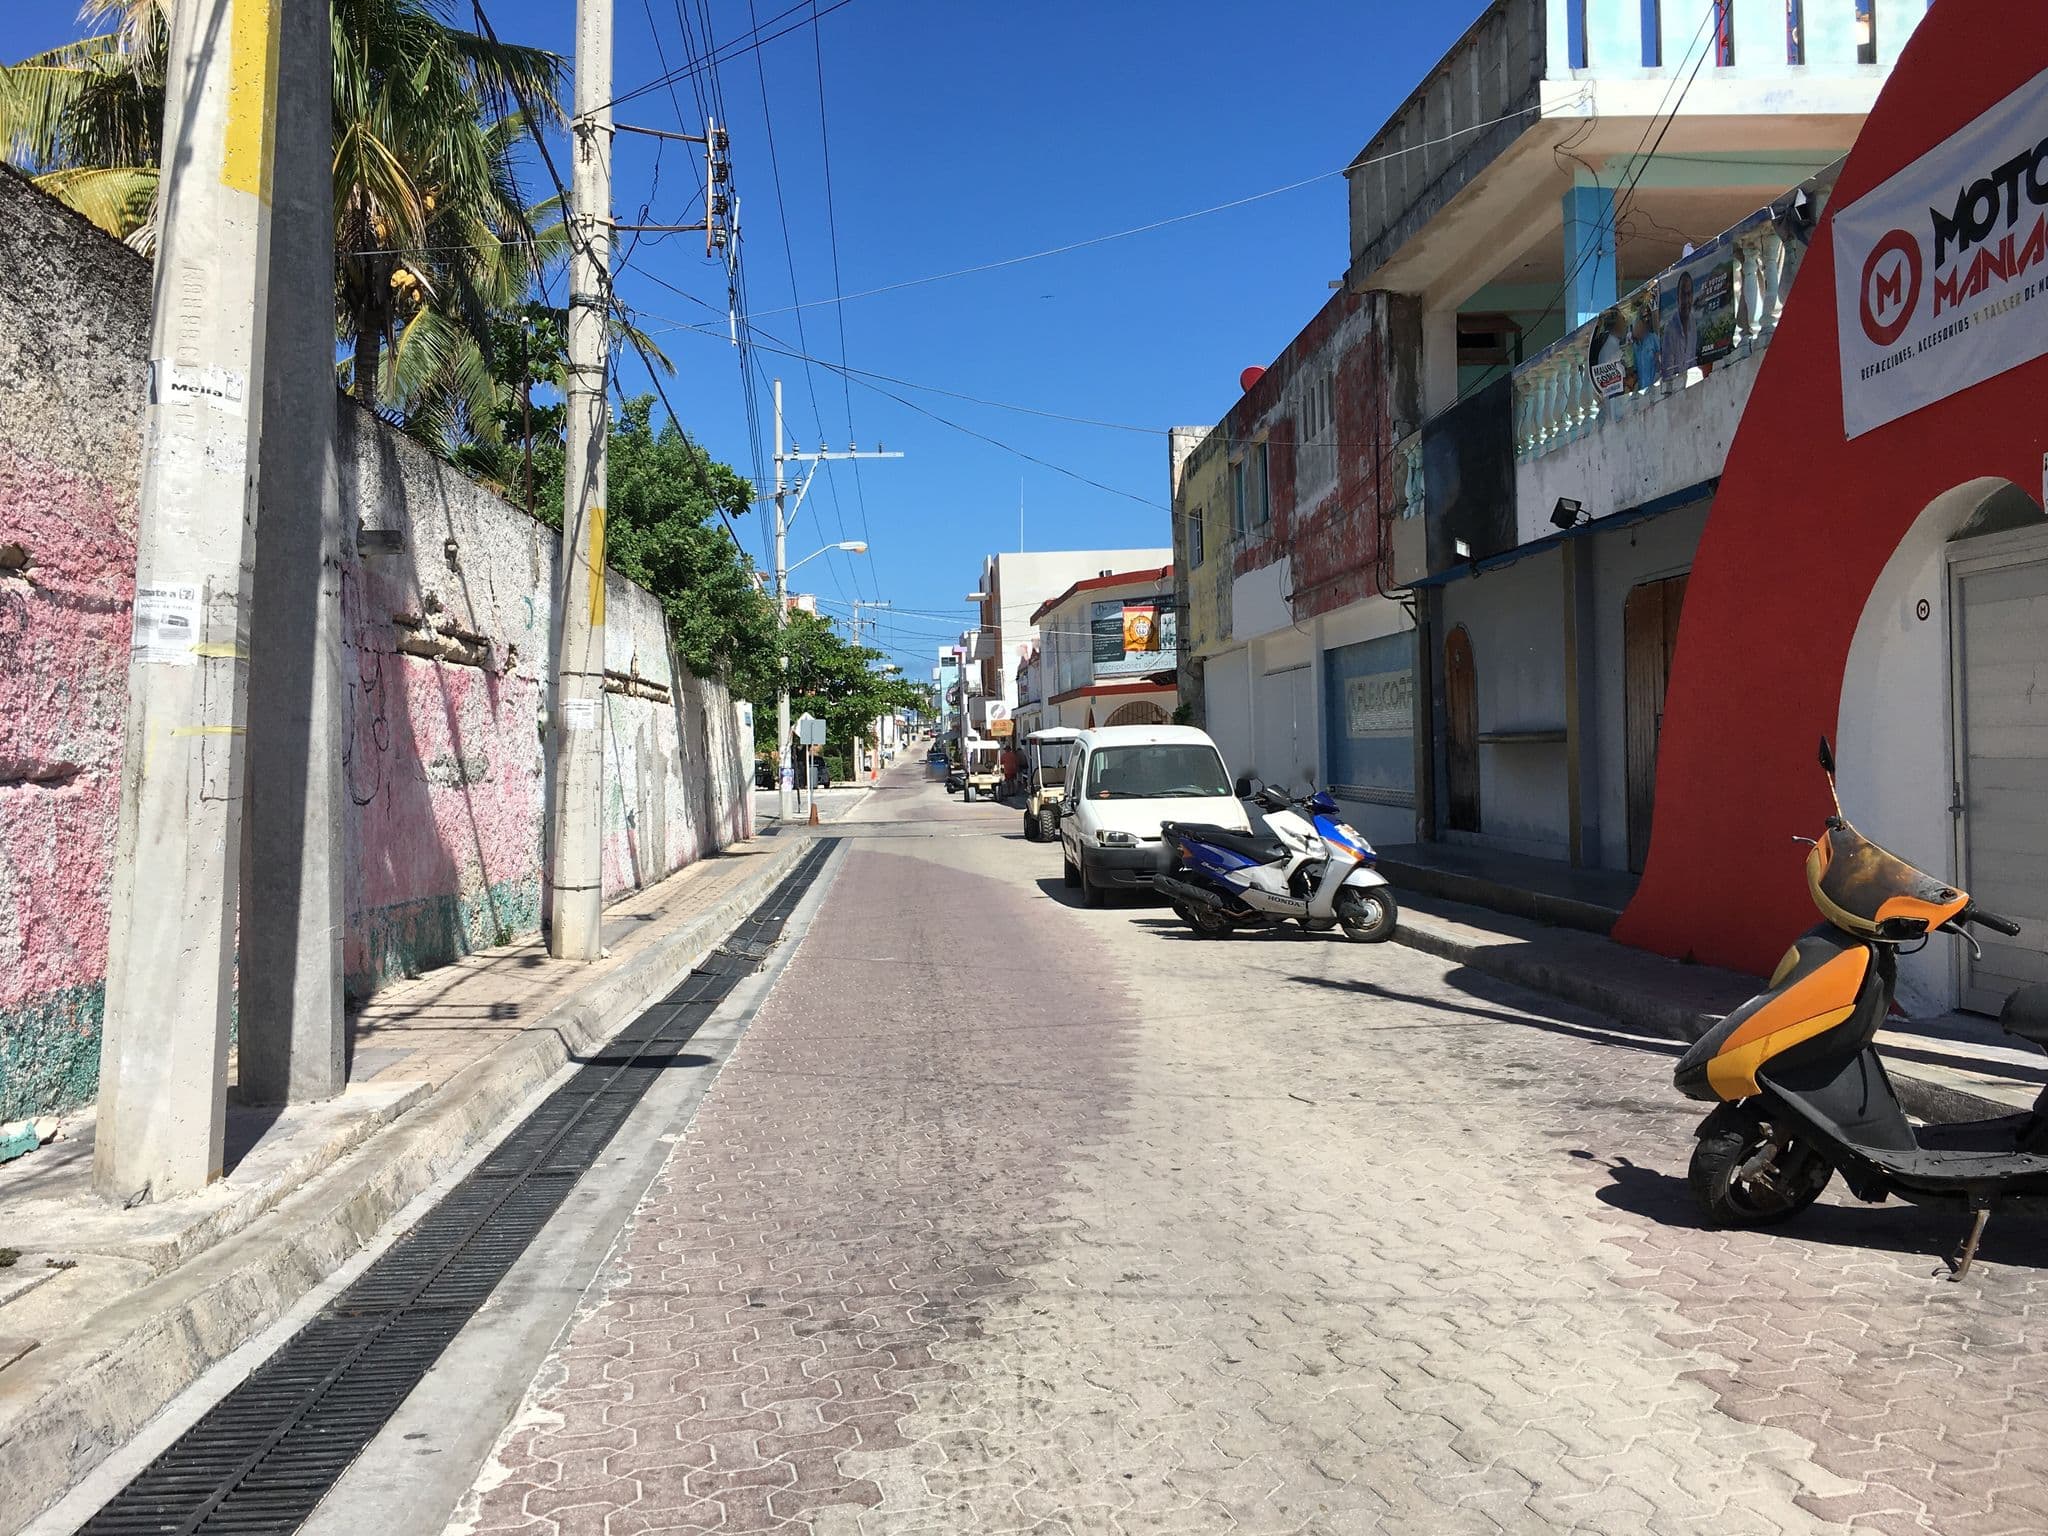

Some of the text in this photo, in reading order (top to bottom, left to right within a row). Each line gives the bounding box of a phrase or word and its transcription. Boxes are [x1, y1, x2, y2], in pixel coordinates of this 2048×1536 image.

[1929, 136, 2048, 270] MOTO
[1933, 210, 2048, 319] MANIA
[1918, 316, 1970, 353] ACCESORIOS
[2024, 284, 2035, 302] DE
[1267, 894, 1301, 908] HONDA
